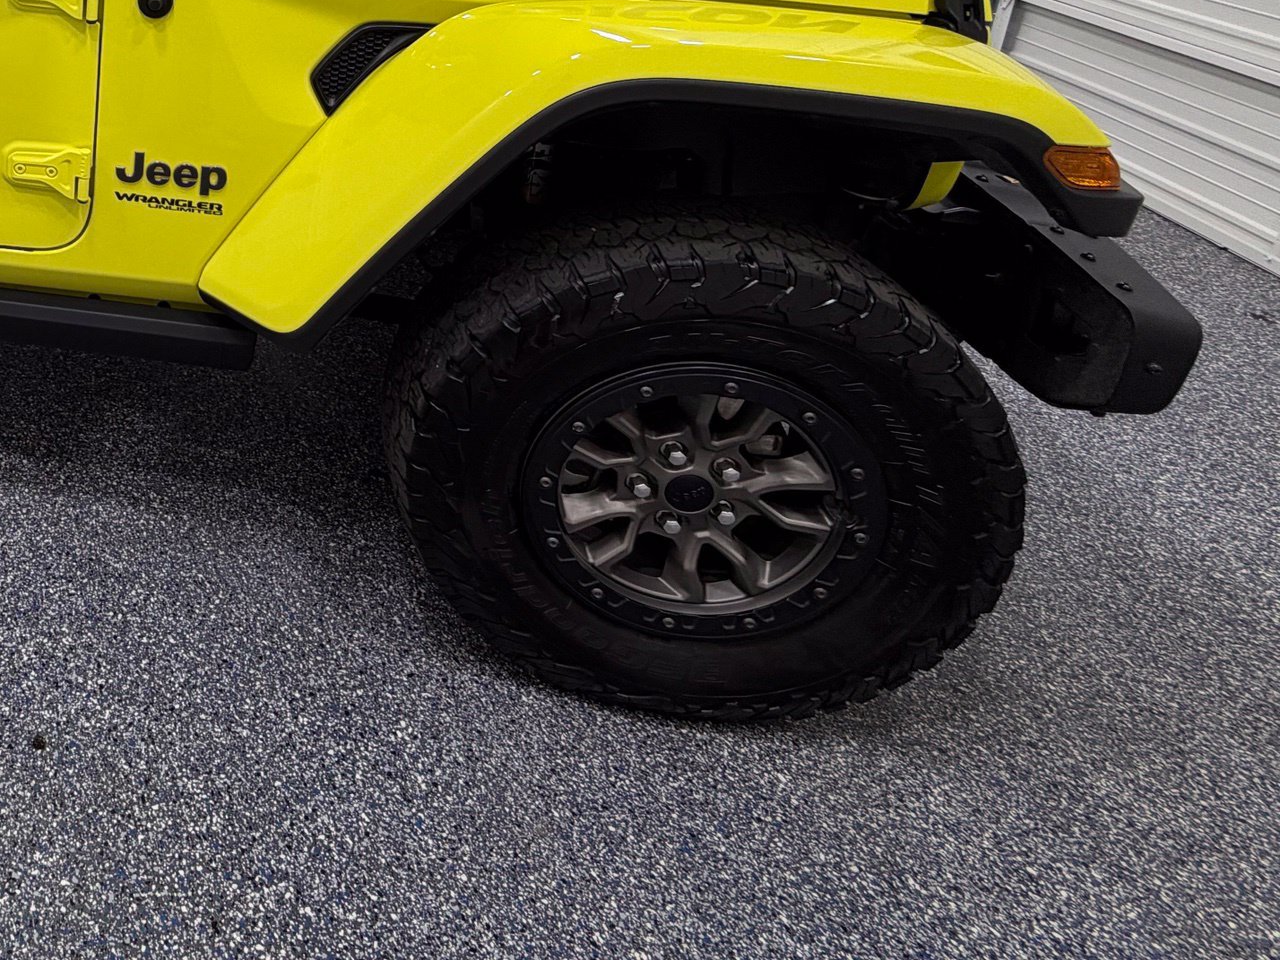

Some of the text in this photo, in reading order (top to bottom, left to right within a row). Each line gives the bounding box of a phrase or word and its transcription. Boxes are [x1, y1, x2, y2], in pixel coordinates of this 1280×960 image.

[115, 151, 228, 196] Jeep
[114, 191, 223, 212] WRANGLER
[147, 203, 223, 216] UNLIMITED
